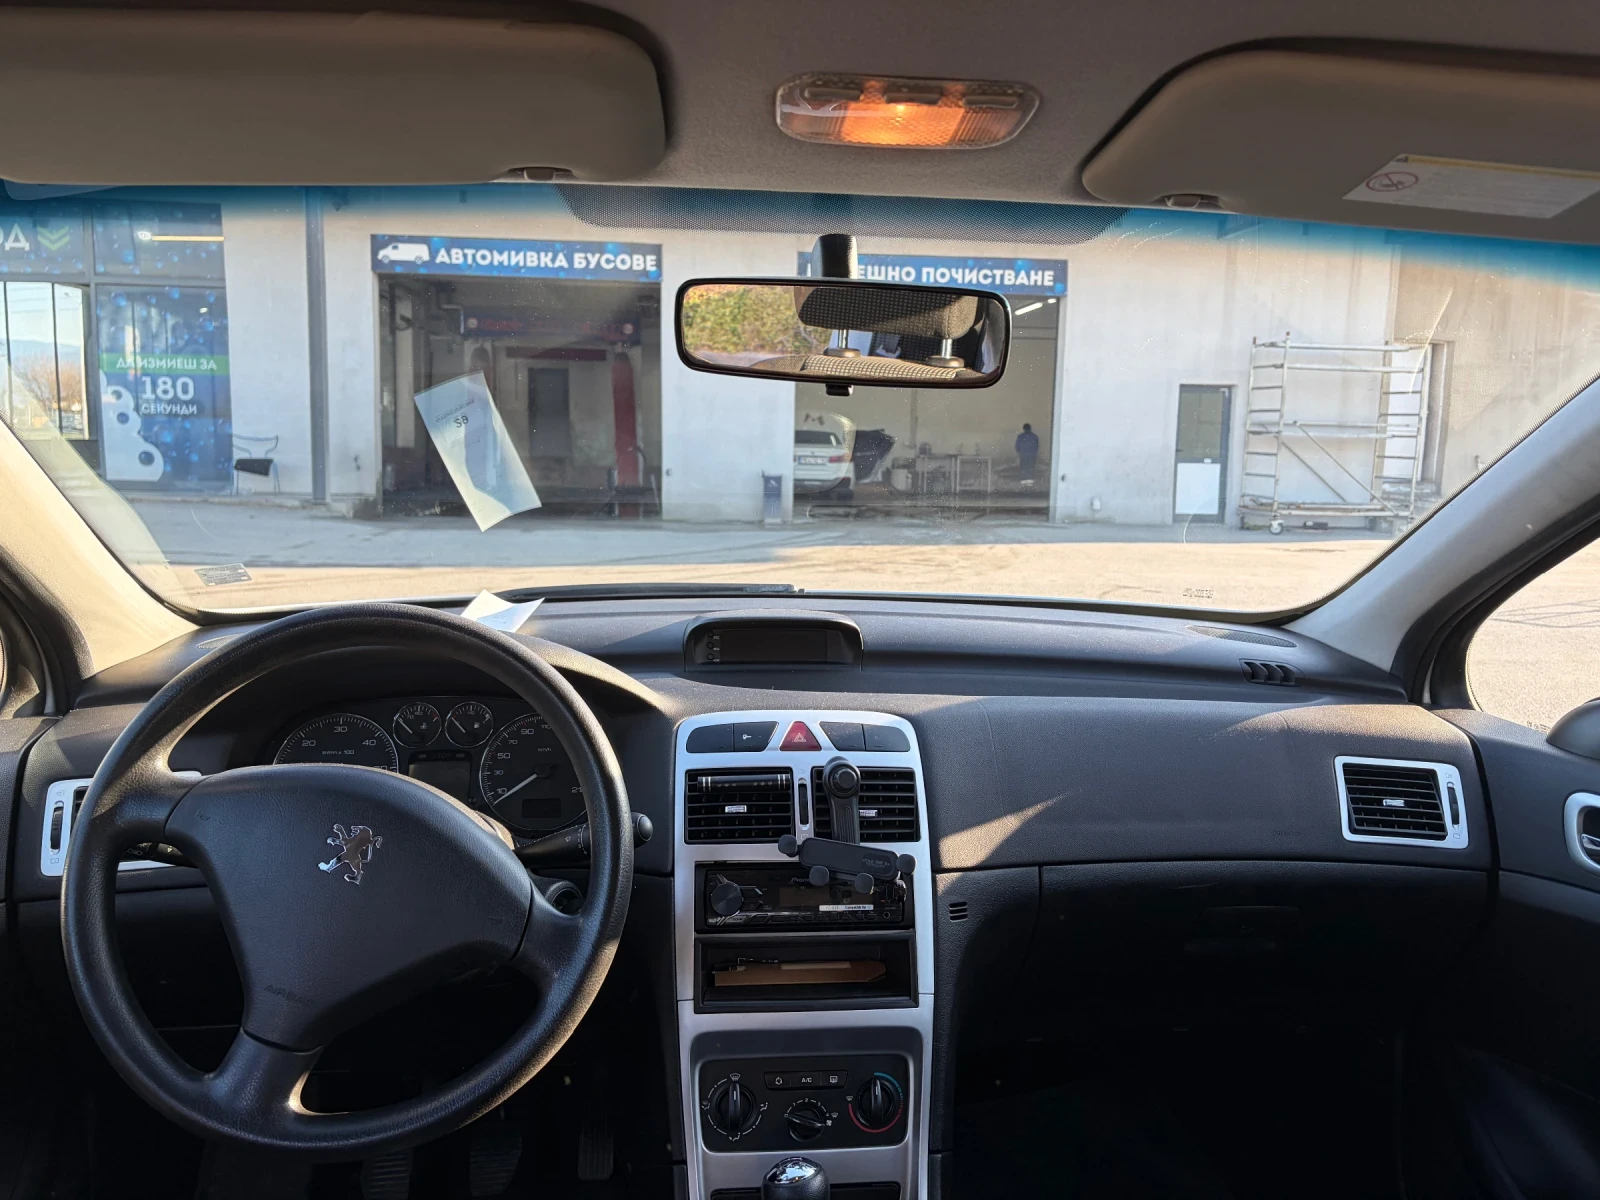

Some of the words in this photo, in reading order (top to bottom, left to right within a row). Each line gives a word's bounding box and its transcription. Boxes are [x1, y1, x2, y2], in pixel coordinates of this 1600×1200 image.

[435, 247, 569, 269] АВТОМИВКА
[573, 251, 657, 271] БУСОВЕ
[921, 266, 1054, 287] ПОЧИСТВАНЕ
[199, 358, 217, 371] ЗА
[141, 376, 195, 401] 180
[141, 403, 198, 416] СЕКУНДИ
[333, 725, 348, 733] 30
[571, 786, 582, 794] 21
